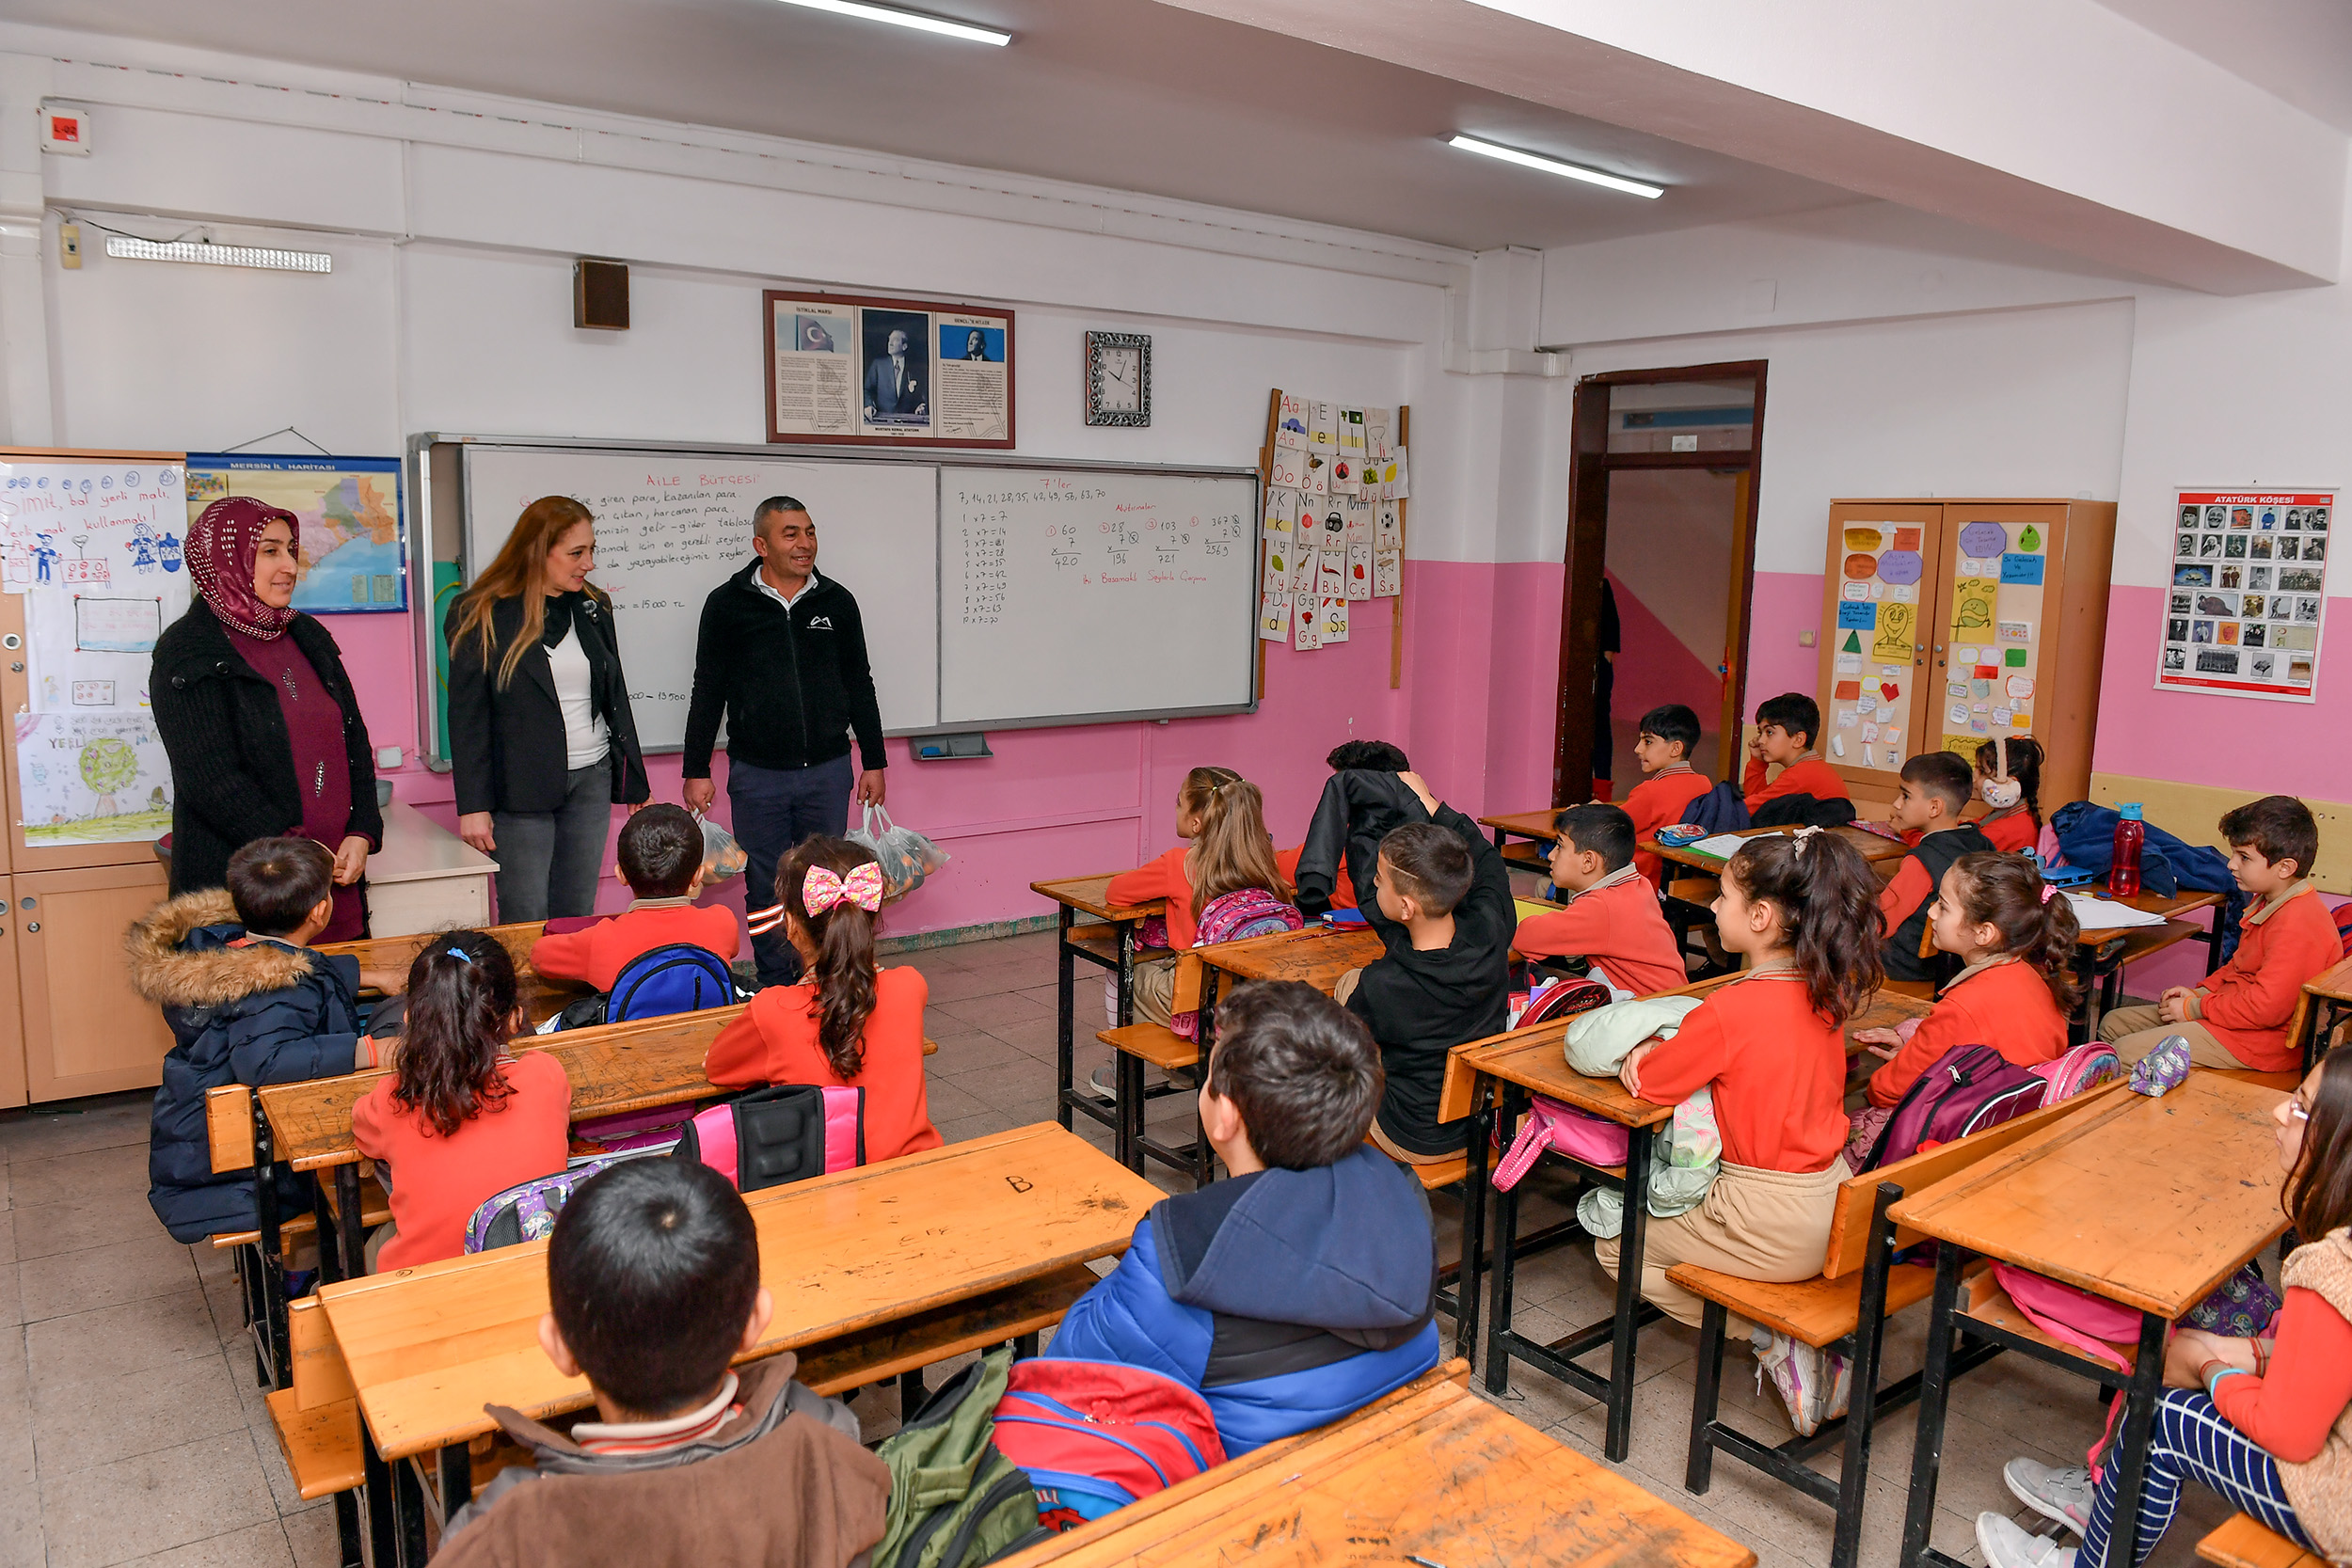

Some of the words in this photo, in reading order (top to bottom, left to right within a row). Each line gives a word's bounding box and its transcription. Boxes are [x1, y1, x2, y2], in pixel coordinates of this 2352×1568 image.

[1319, 404, 1327, 420] E
[1318, 432, 1326, 444] e
[230, 462, 271, 470] MERSİN
[288, 463, 336, 471] HARİTASI
[69, 492, 89, 506] bal
[100, 491, 128, 508] yerli
[1277, 492, 1287, 508] K
[2215, 495, 2257, 504] ATATÜRK
[2260, 495, 2295, 505] KÖŞESİ
[1160, 521, 1177, 531] 103
[1212, 515, 1228, 527] 367
[1275, 510, 1282, 531] k
[43, 521, 67, 534] malı
[1061, 524, 1076, 535] 60
[1111, 521, 1125, 533] 28
[1068, 537, 1075, 547] 7
[1119, 533, 1125, 545] 7
[1206, 545, 1229, 557] 2569
[1055, 555, 1078, 572] 420
[1112, 553, 1126, 565] 196
[1158, 554, 1175, 563] 721
[1272, 594, 1283, 607] D
[1269, 610, 1279, 631] d
[1006, 1176, 1034, 1193] B
